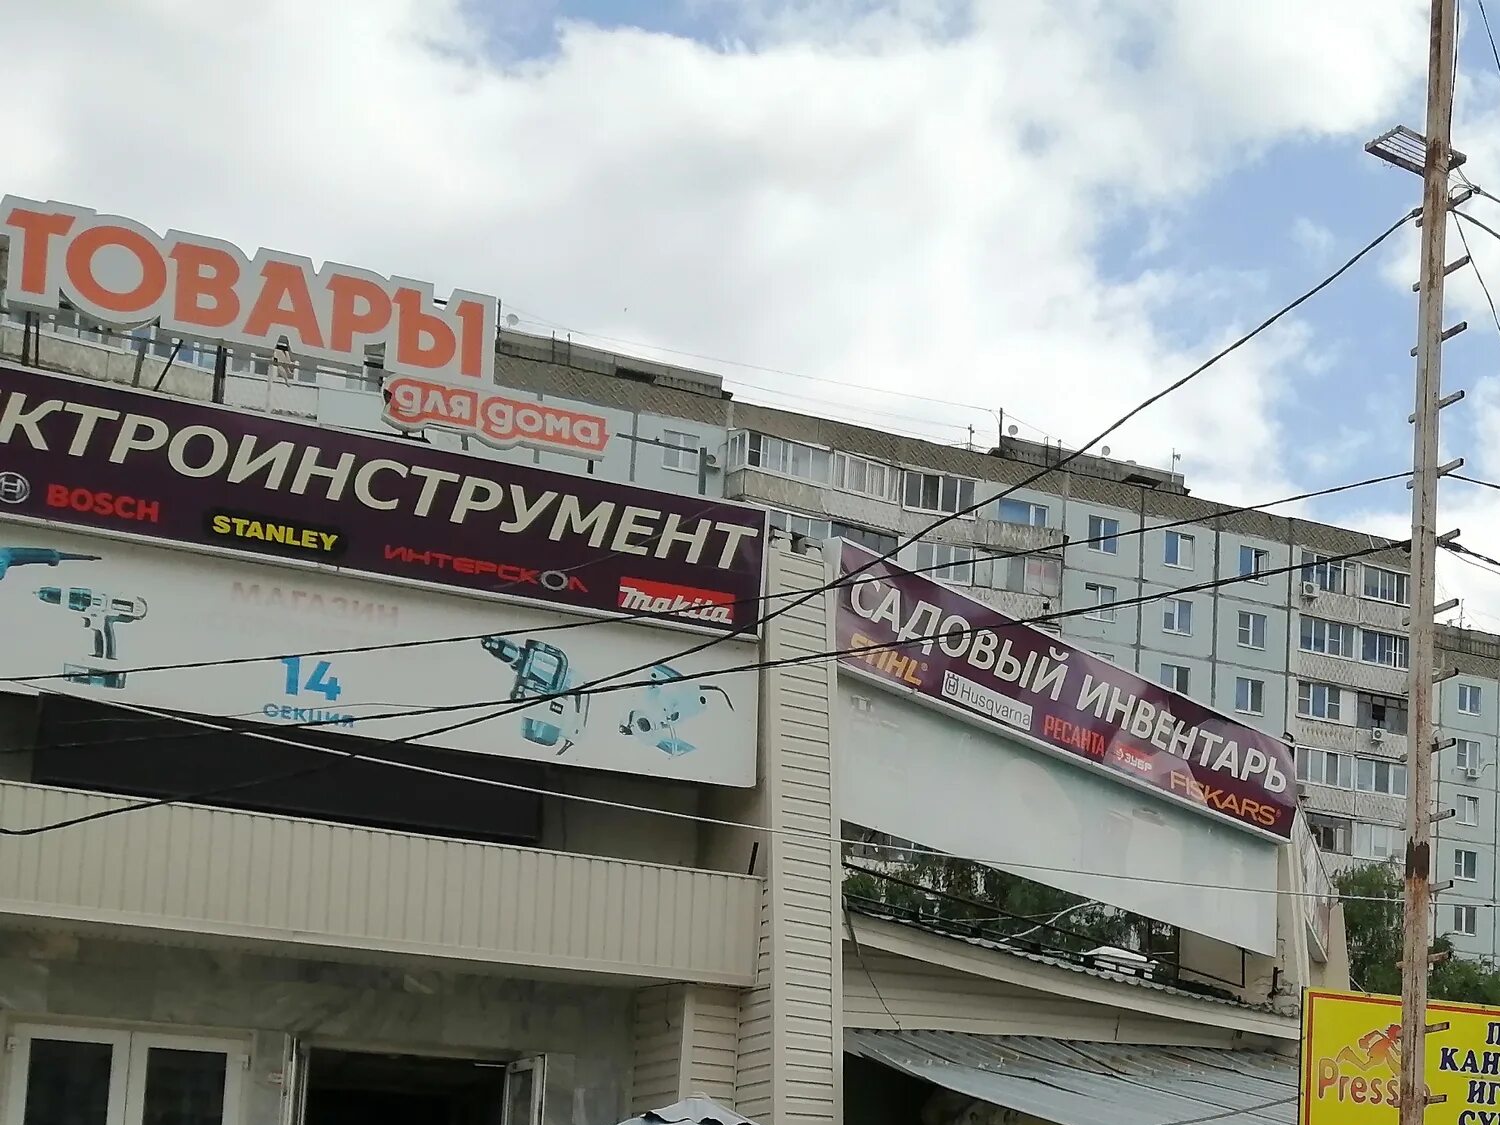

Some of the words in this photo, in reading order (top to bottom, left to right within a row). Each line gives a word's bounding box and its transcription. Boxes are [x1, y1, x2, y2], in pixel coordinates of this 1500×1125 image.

[4, 208, 484, 378] ТОВАРЫ
[391, 380, 472, 418] для
[485, 400, 603, 448] дома
[0, 388, 758, 571] КТРОИНСТРУМЕНТ
[46, 483, 160, 524] BOSCH
[212, 515, 338, 552] STANLEY
[384, 545, 589, 593] ИНТЕРСКОЛ
[230, 581, 400, 627] МАГАЗИН
[278, 656, 342, 702] 14
[849, 573, 1071, 702] САДОВЫЙ
[1076, 674, 1288, 793] ИНВЕНТАРЬ
[261, 702, 356, 730] СЕКЦИЯ
[960, 682, 1032, 729] Husqvarna
[1043, 714, 1105, 756] РЕСАНТА
[1124, 751, 1153, 773] ЗУБР
[1317, 1057, 1431, 1108] Press
